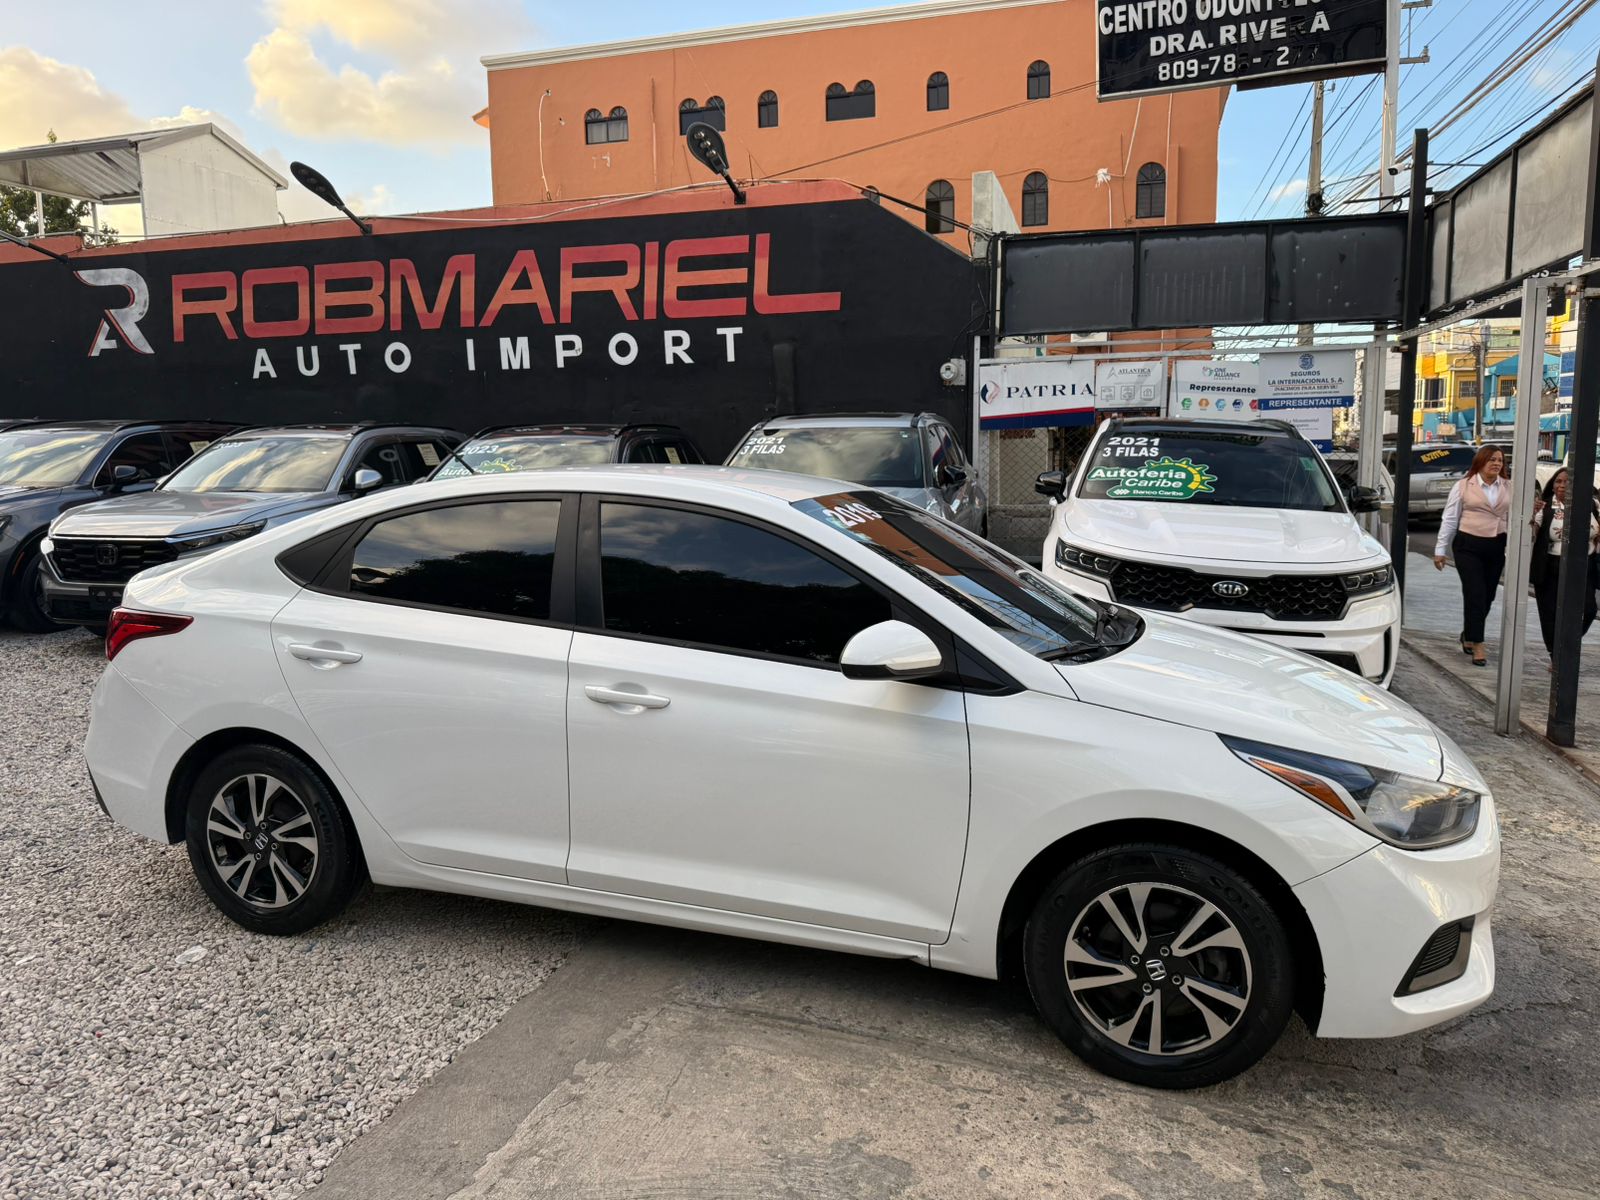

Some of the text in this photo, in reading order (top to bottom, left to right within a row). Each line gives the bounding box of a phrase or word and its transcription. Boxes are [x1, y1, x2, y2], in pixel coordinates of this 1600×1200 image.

[1099, 0, 1188, 35] CENTRO
[1150, 30, 1214, 56] DRA.
[172, 233, 842, 342] ROBMARIEL
[252, 326, 744, 379] AUTO IMPORT
[1007, 383, 1094, 398] PATRIA
[1190, 384, 1257, 394] Representante
[1268, 398, 1343, 408] REPRESENTANTE
[747, 437, 784, 445] 2021
[1107, 437, 1160, 446] 2021
[457, 445, 499, 455] 2023
[740, 445, 787, 455] 3 FILAS
[1102, 447, 1160, 457] 3 FILAS
[1091, 468, 1187, 479] Autoferia
[1125, 478, 1183, 488] Caribe
[822, 503, 883, 527] 2019
[1217, 583, 1244, 595] KIA
